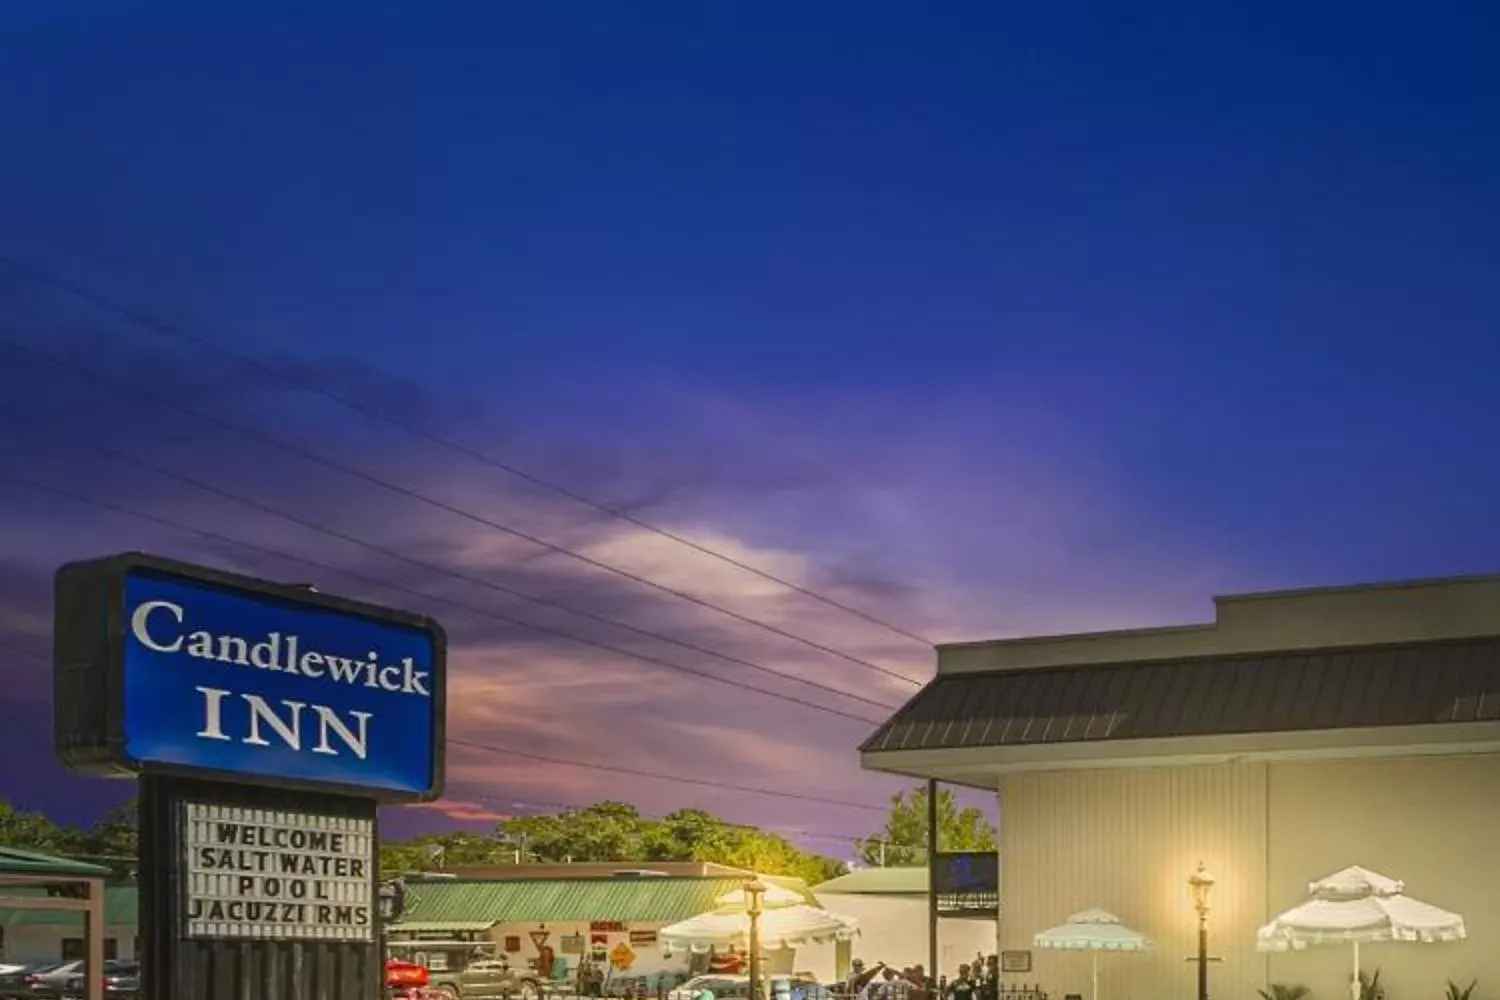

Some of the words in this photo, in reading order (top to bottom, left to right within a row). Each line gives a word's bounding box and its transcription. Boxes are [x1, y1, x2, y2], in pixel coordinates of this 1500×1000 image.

[130, 601, 431, 697] Candlewick
[195, 685, 373, 759] INN
[218, 824, 343, 852] WELCOME
[201, 848, 267, 871] SALT
[281, 853, 363, 877] WATER
[239, 877, 328, 900] POOL
[186, 900, 304, 922] JACUZZI
[318, 905, 369, 925] RMS
